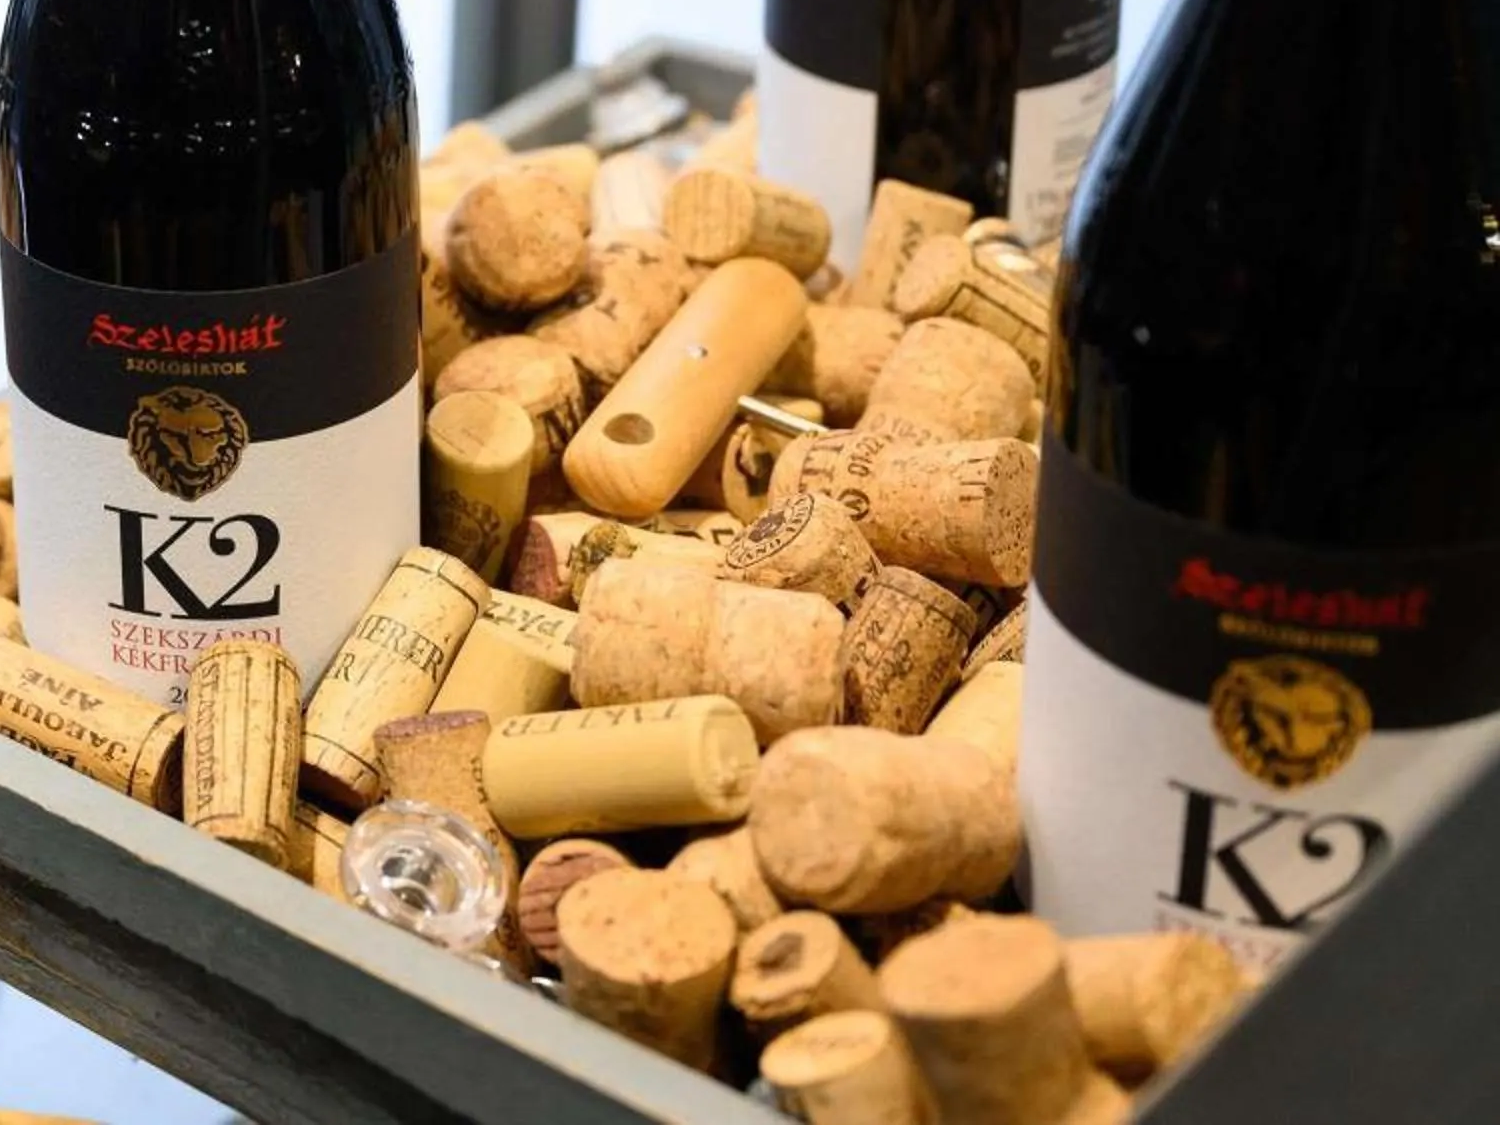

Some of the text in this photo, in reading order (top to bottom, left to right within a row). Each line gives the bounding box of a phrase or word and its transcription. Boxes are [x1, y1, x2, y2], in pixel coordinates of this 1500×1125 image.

[86, 313, 286, 354] Szeleshát
[103, 504, 281, 621] K2
[111, 642, 192, 675] KÉKFR
[1156, 778, 1393, 933] K2
